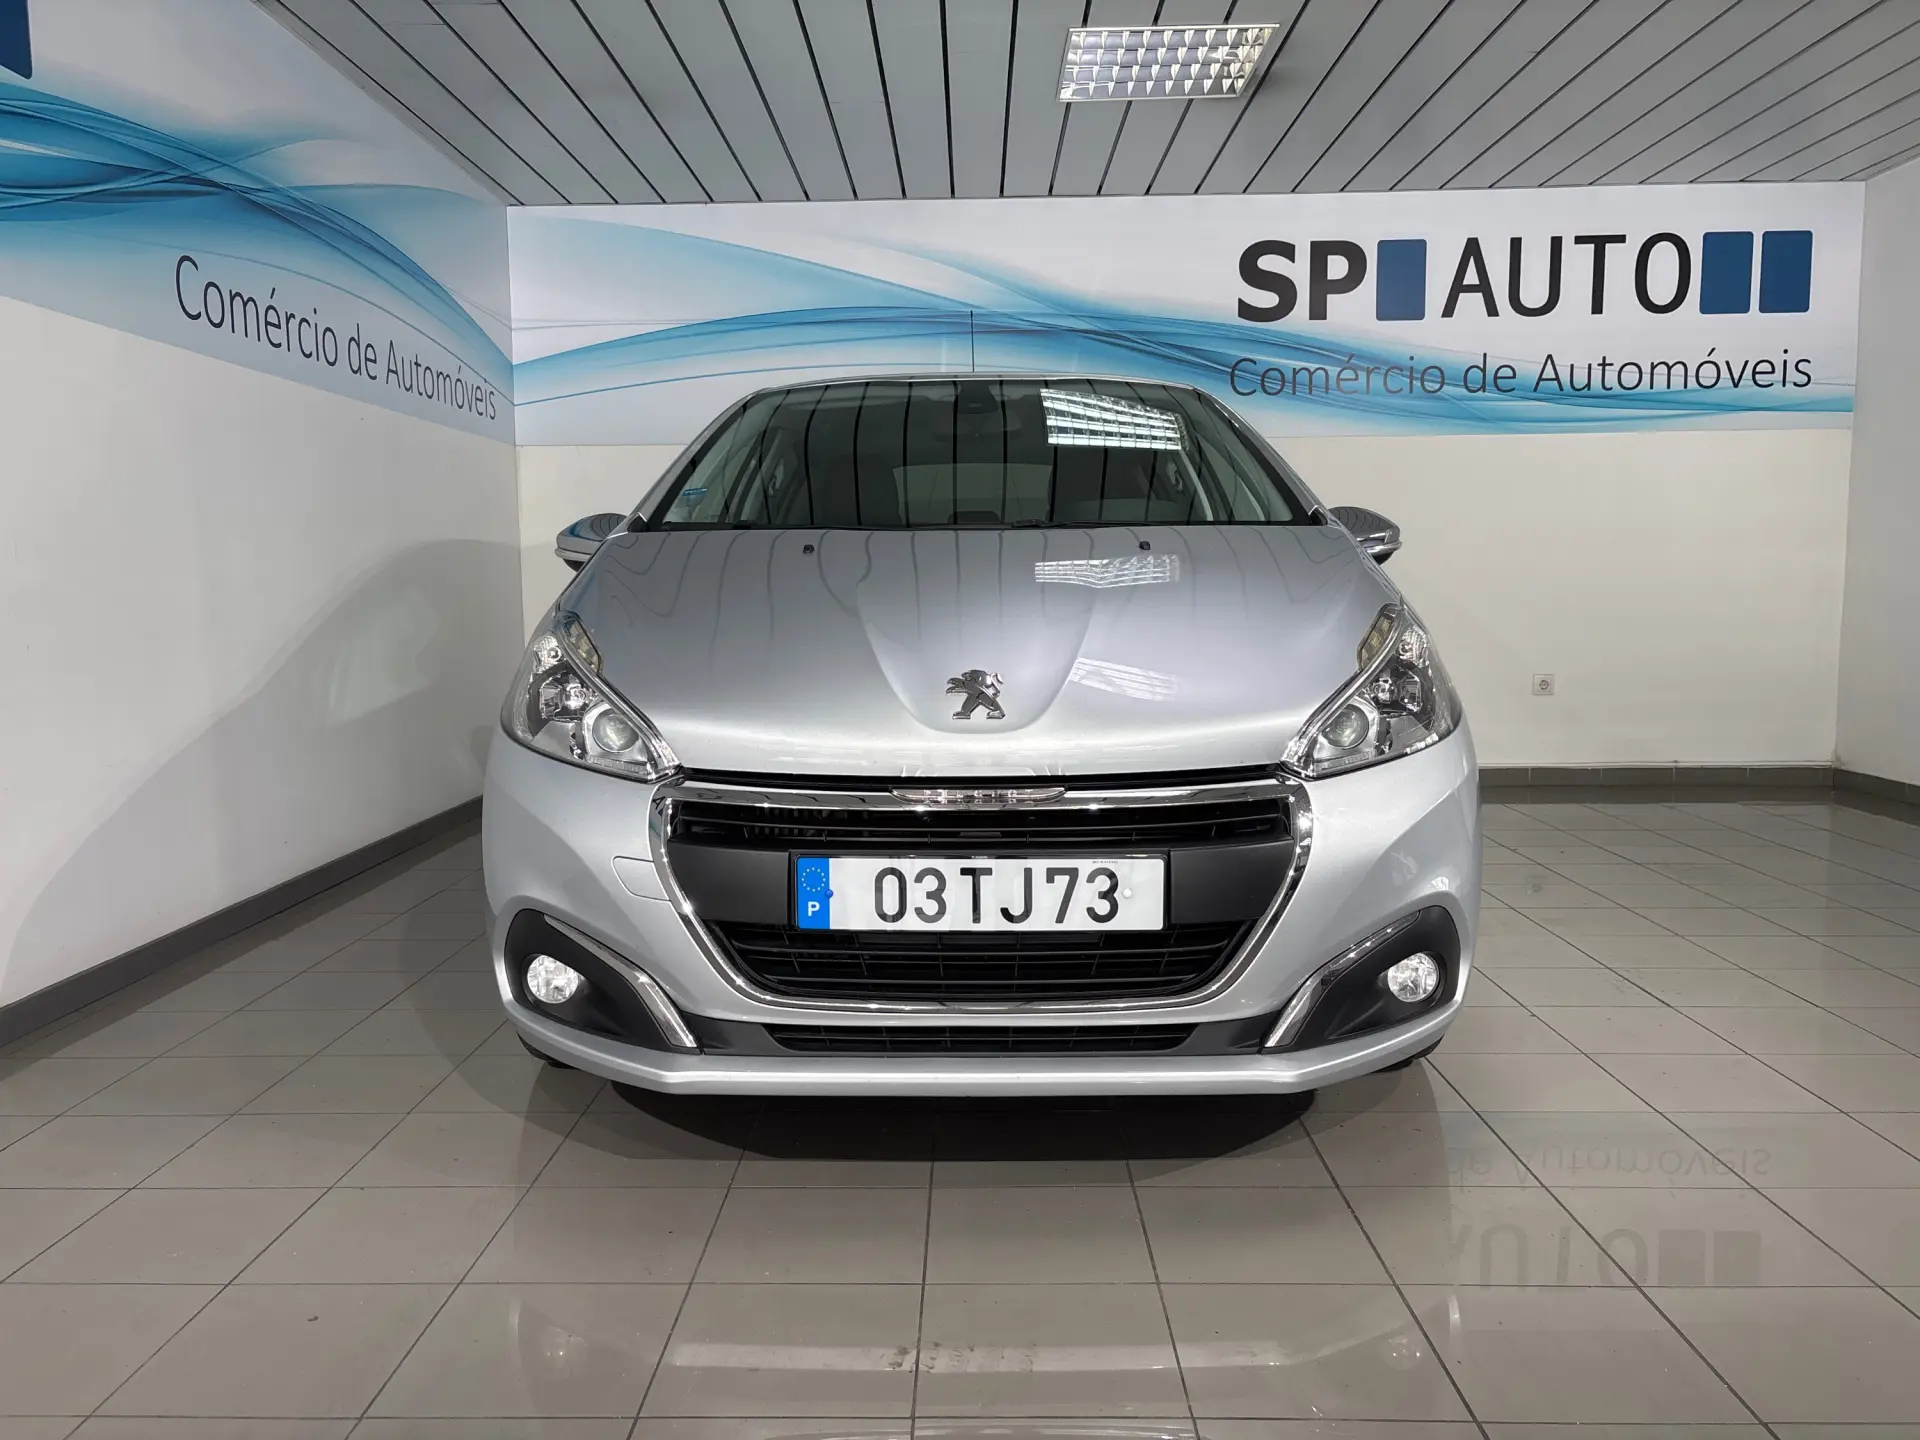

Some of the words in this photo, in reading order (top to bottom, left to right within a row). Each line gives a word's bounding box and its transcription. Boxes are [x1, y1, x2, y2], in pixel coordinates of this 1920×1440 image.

[1237, 239, 1368, 322] SP
[1441, 231, 1692, 319] AUTO
[175, 254, 338, 367] Comércio
[347, 323, 378, 380] de
[385, 340, 497, 420] Automóveis
[1229, 354, 1446, 397] Comércio
[1463, 352, 1518, 394] de
[1533, 347, 1814, 394] Automóveis
[807, 902, 820, 917] P
[874, 866, 1119, 924] 03TJ73
